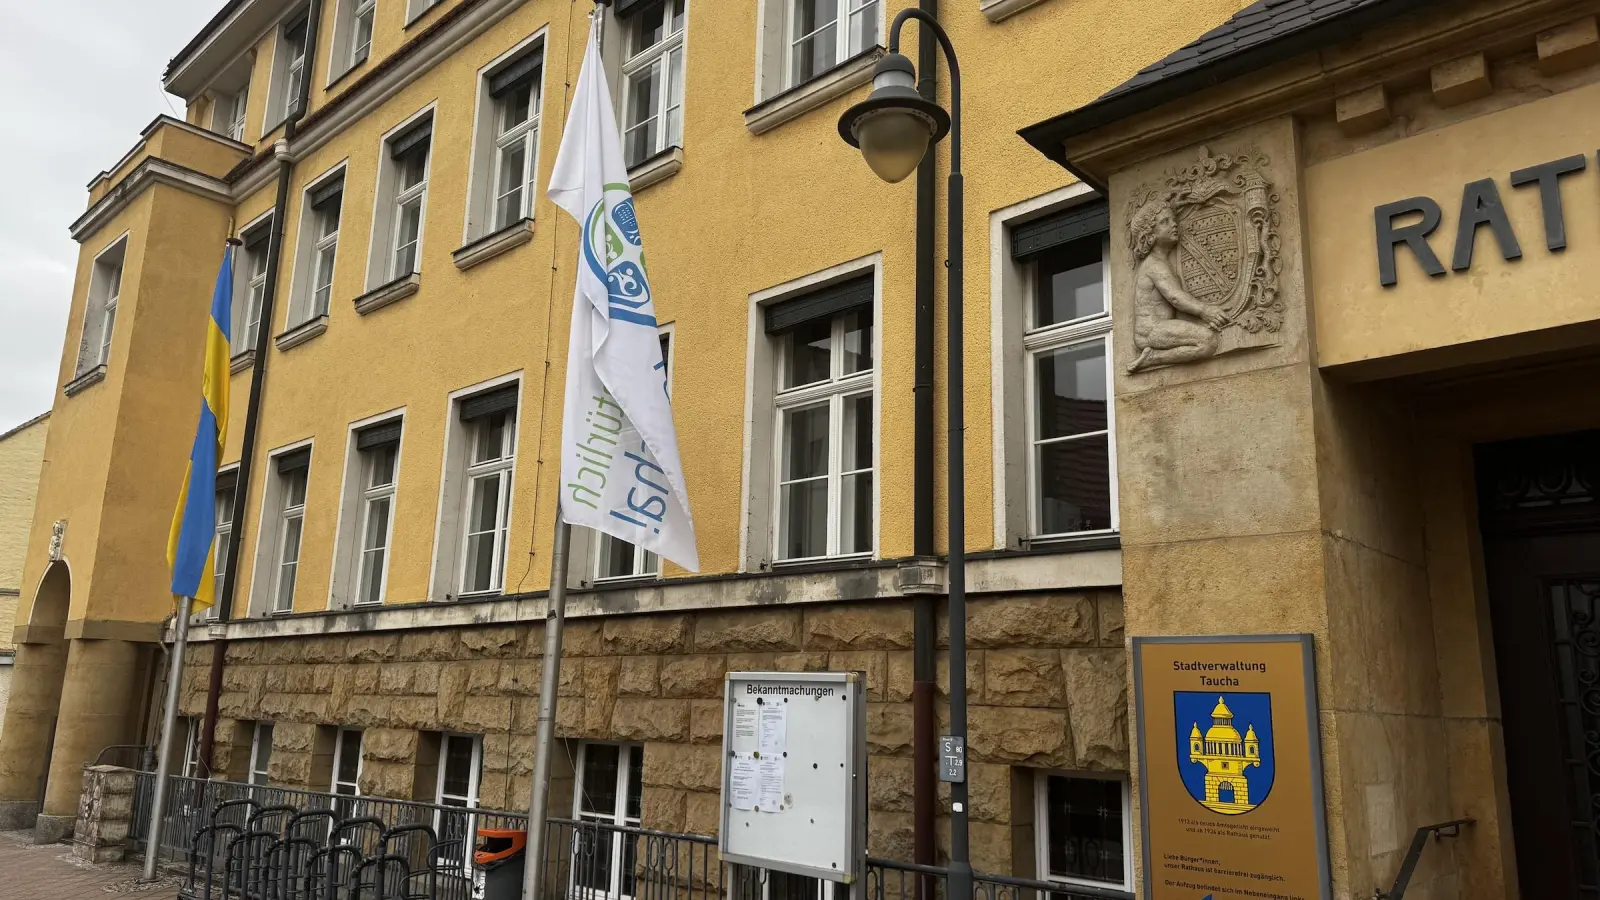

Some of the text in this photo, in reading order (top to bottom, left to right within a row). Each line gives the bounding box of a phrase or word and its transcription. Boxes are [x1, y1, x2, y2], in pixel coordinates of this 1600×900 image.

[1374, 149, 1600, 288] RAT
[1173, 661, 1266, 673] Stadtverwaltung
[1200, 676, 1239, 686] Taucha
[746, 684, 834, 698] Bekanntmachungen
[945, 742, 951, 752] S
[1227, 830, 1248, 838] Rathaus
[1181, 863, 1205, 873] Rathaus
[1214, 868, 1249, 878] barrierefrei
[1250, 872, 1286, 882] zugänglich.
[1176, 881, 1196, 890] Aufzug
[1196, 883, 1221, 893] befindet
[1221, 886, 1234, 894] sich
